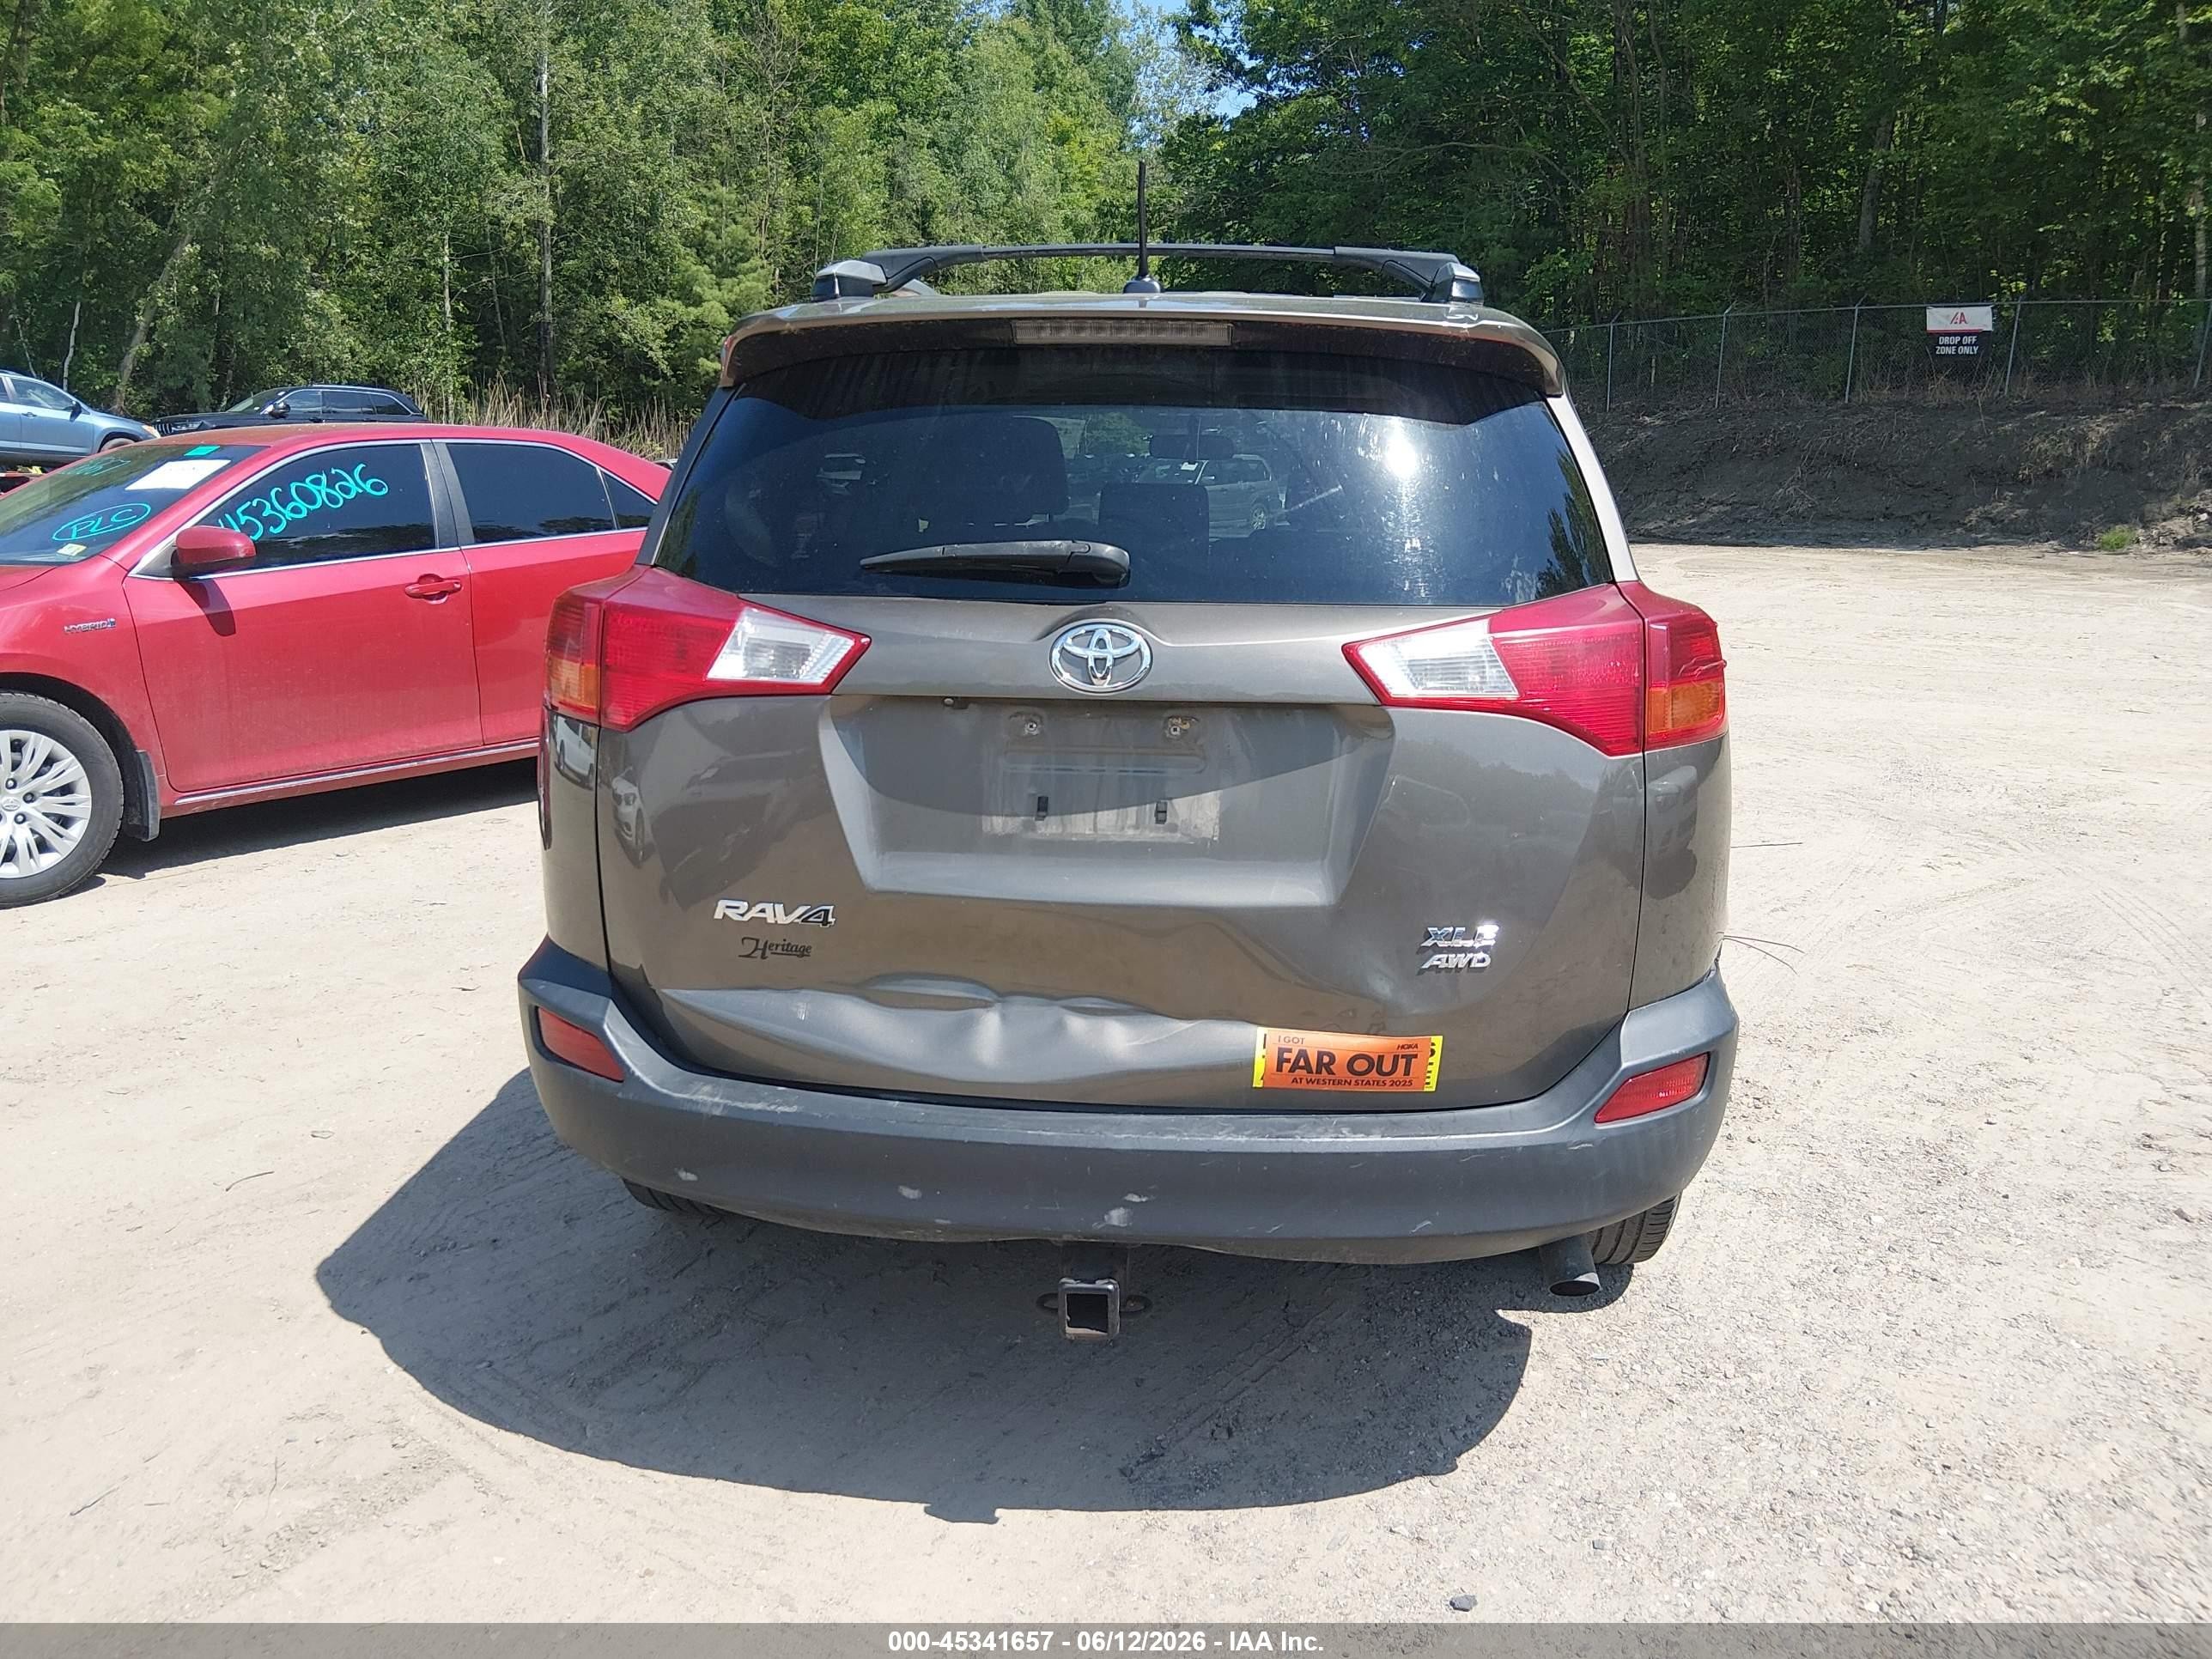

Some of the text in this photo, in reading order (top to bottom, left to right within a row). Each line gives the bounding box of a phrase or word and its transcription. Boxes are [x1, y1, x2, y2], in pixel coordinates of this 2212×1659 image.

[1939, 336, 1978, 345] DROP OFF
[1936, 346, 1978, 355] ZONE ONLY
[714, 899, 836, 927] RAV4
[1420, 924, 1499, 948] XLE
[738, 936, 812, 960] Heritage
[1421, 952, 1492, 969] AWD
[1283, 1036, 1305, 1045] GOT
[1276, 1047, 1336, 1075] FAR
[1346, 1053, 1419, 1077] OUT
[1305, 1078, 1352, 1086] WESTERN
